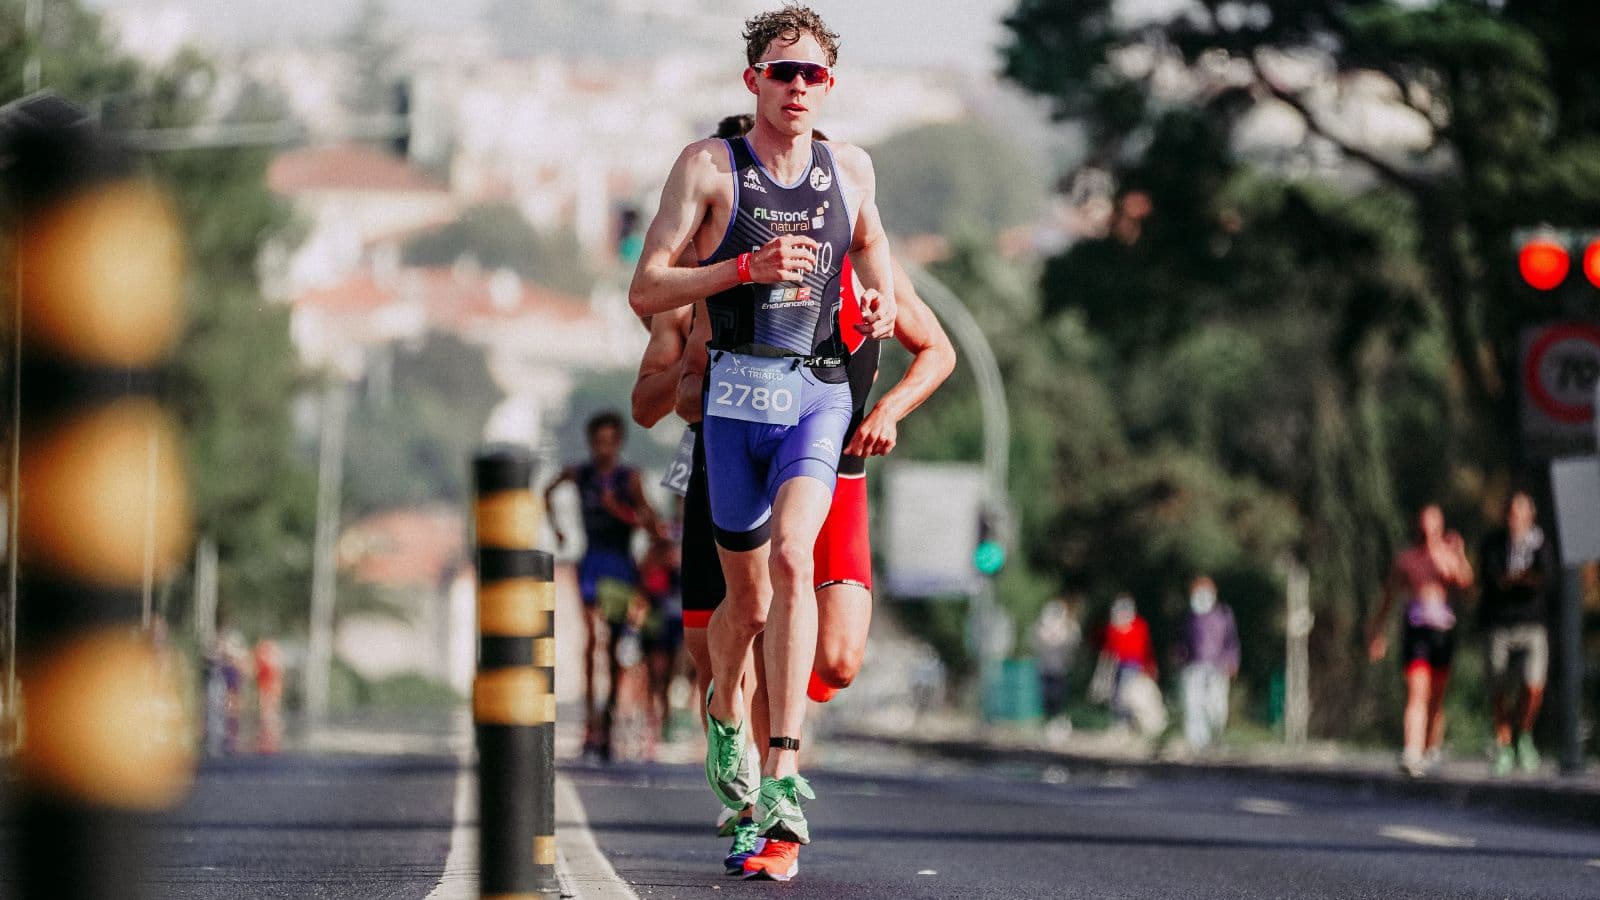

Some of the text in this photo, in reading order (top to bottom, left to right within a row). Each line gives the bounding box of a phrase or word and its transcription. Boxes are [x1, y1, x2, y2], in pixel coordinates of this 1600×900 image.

[753, 207, 809, 221] FILSTONE
[771, 220, 809, 231] natural
[716, 381, 793, 412] 2780
